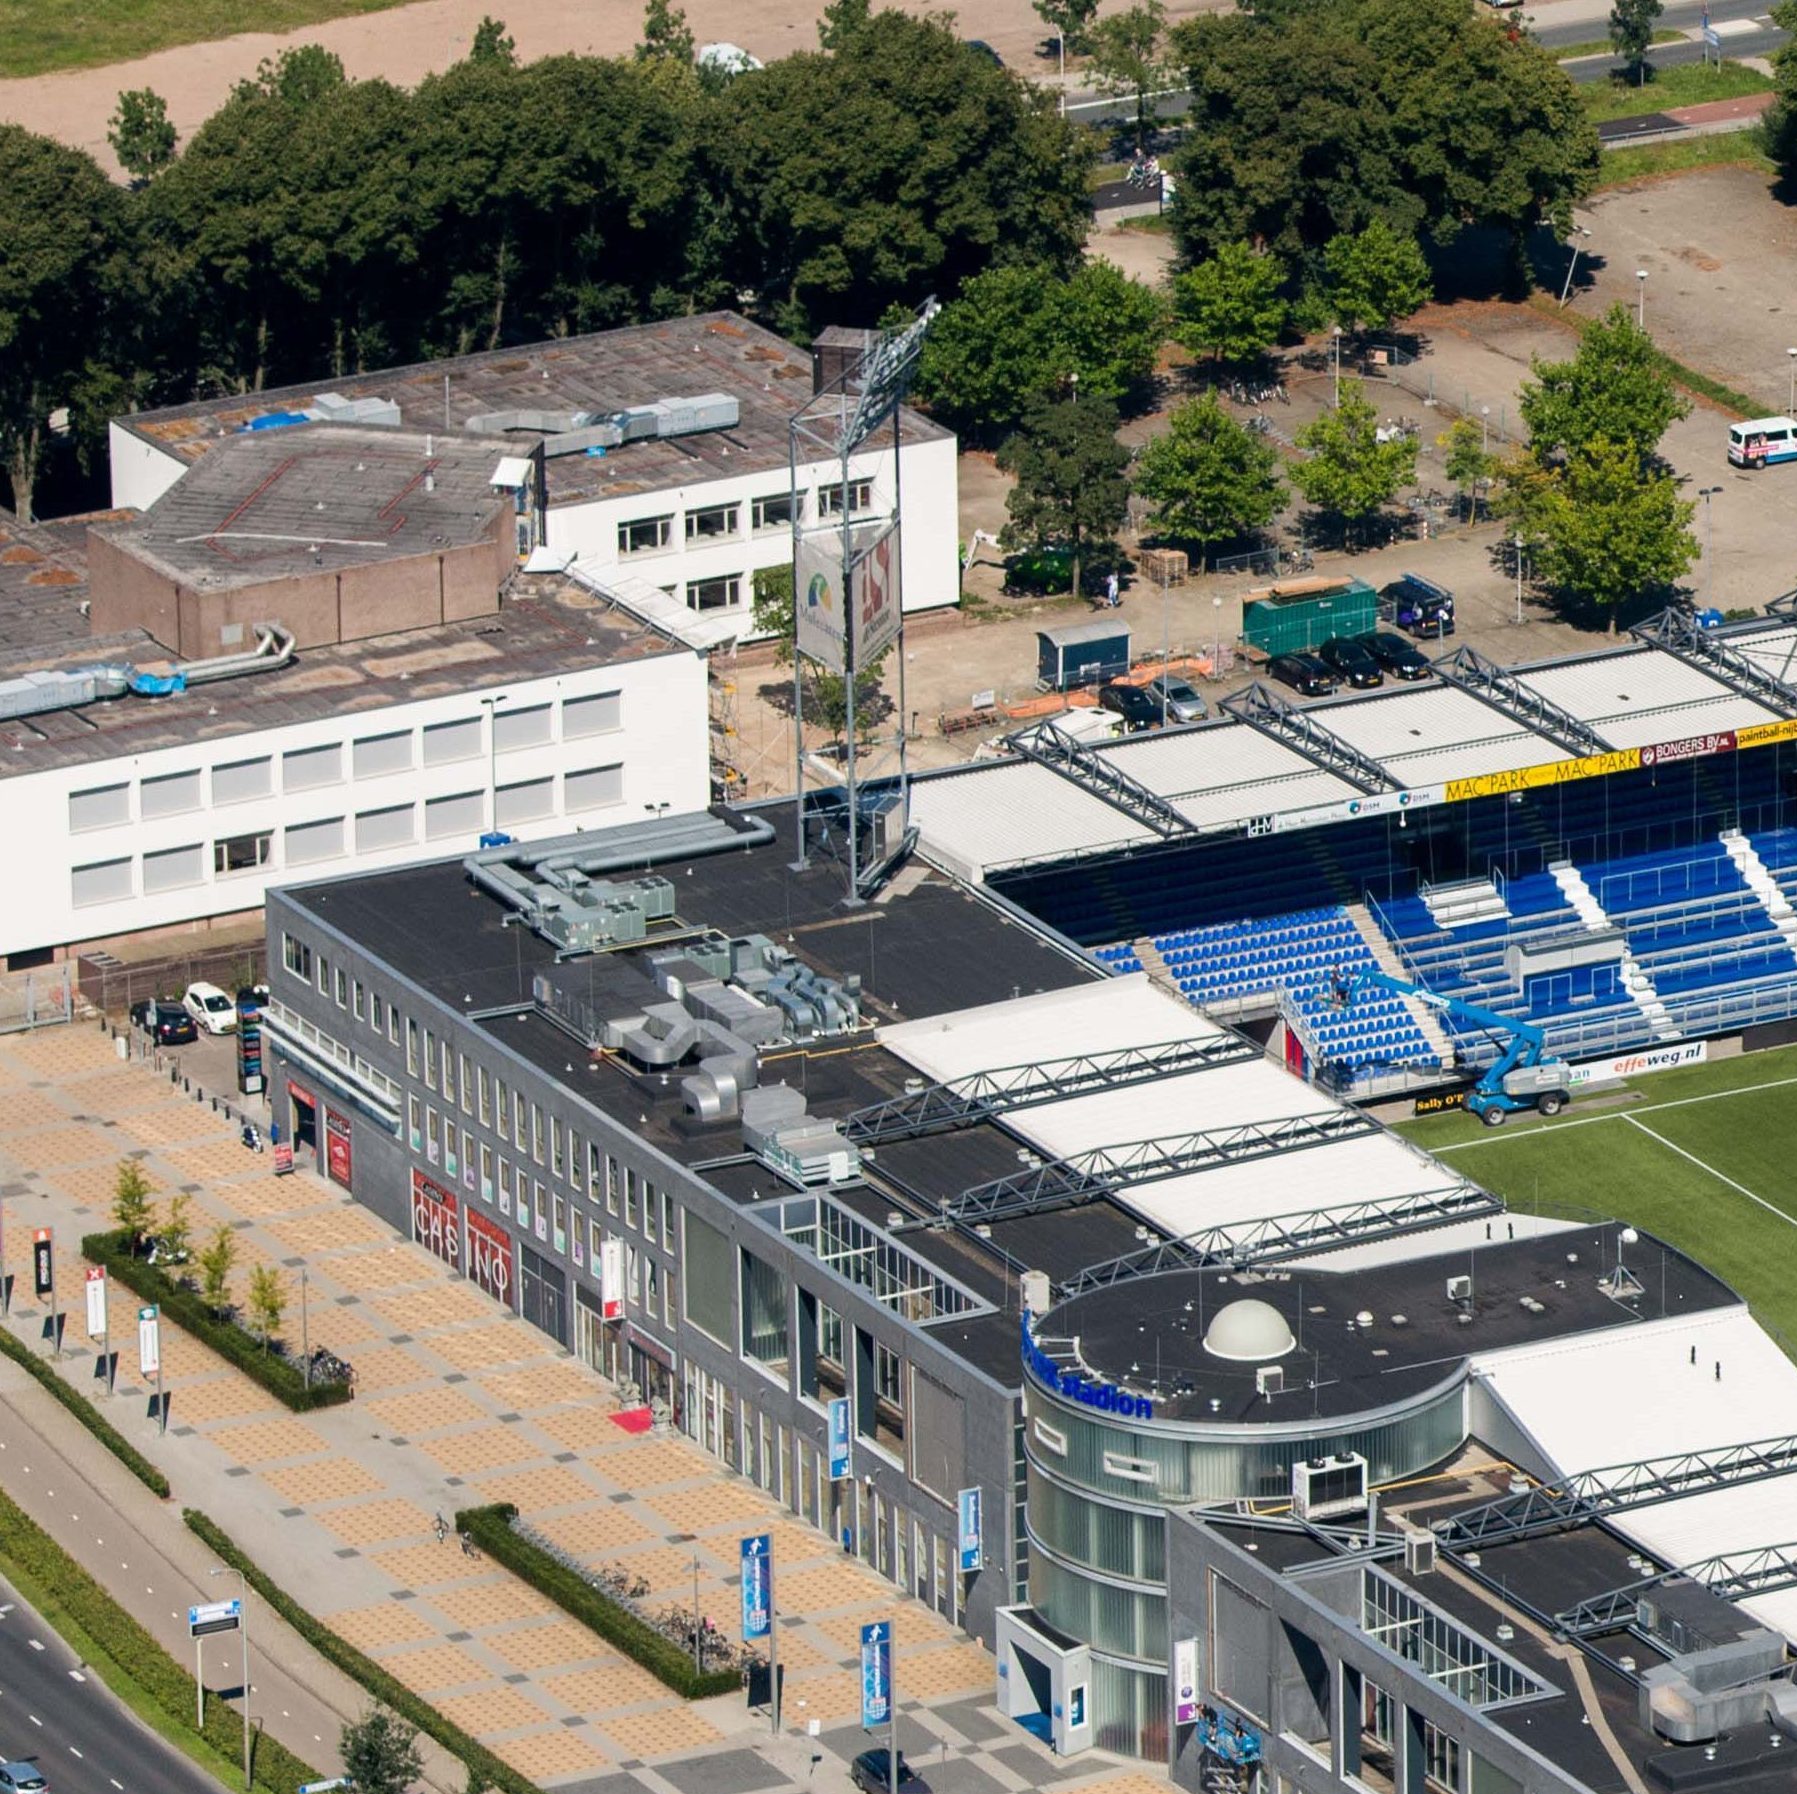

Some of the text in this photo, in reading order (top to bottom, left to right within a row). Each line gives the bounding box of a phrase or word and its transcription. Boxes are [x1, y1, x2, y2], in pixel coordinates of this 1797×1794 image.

[1656, 741, 1703, 760] BONGERS
[1613, 1045, 1702, 1074] effeweg.nl
[1061, 1374, 1152, 1420] stadion
